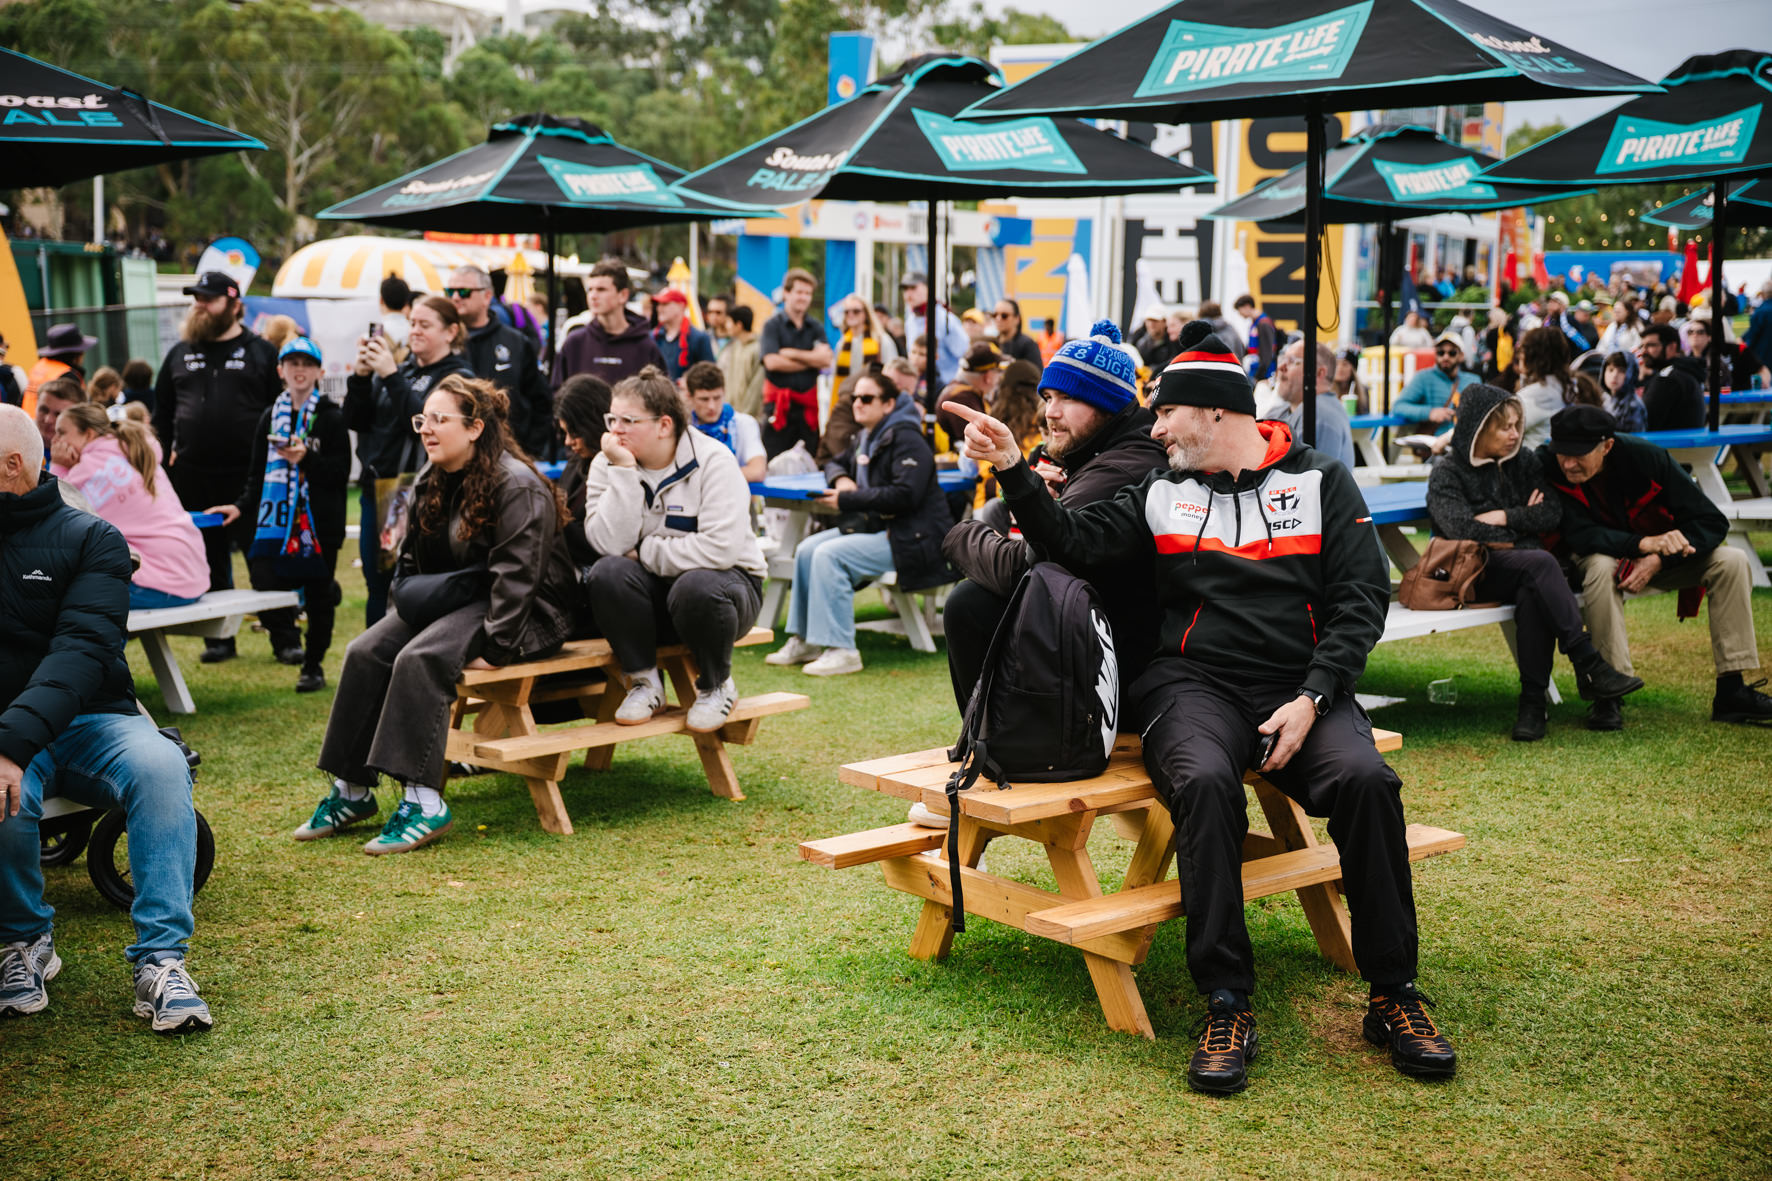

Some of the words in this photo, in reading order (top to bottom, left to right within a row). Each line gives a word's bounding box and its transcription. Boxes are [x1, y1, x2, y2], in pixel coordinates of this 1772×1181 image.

[0, 94, 108, 110] oast
[3, 109, 124, 127] ALE
[1092, 353, 1121, 375] BIG
[1175, 502, 1213, 515] peppe
